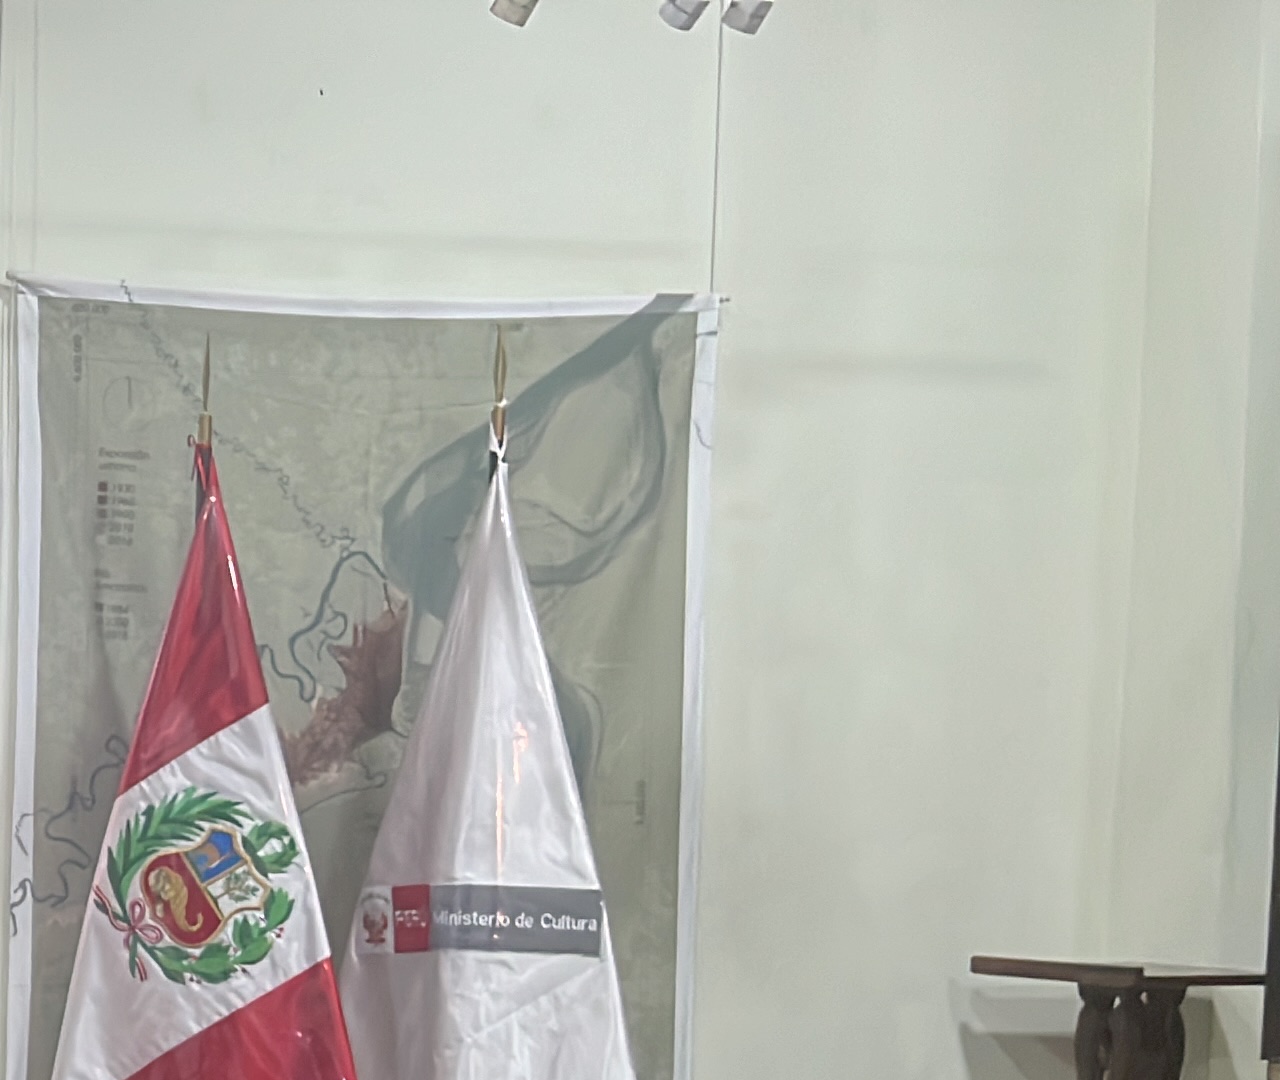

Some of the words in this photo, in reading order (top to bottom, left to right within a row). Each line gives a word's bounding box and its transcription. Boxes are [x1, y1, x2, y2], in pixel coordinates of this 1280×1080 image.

[433, 910, 511, 928] Ministerio
[514, 911, 535, 929] de
[540, 912, 598, 932] Cultura
